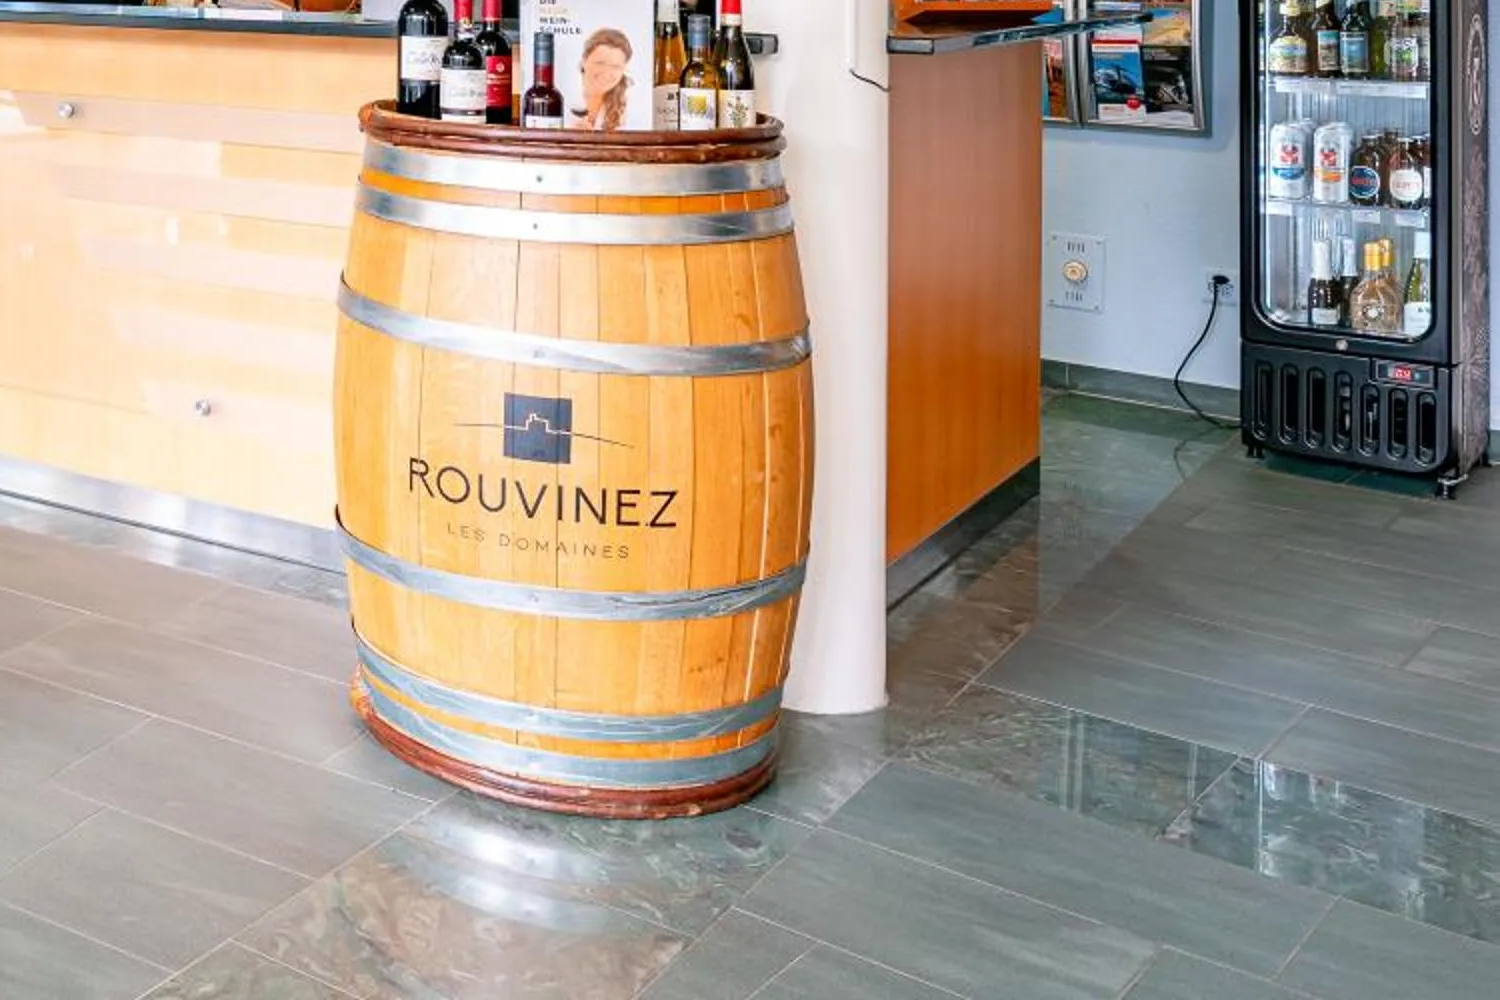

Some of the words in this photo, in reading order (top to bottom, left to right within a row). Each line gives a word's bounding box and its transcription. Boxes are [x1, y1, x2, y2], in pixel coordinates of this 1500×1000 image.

[408, 456, 679, 529] ROUVINEZ
[446, 522, 486, 542] LES
[499, 534, 631, 560] DOMAINES
